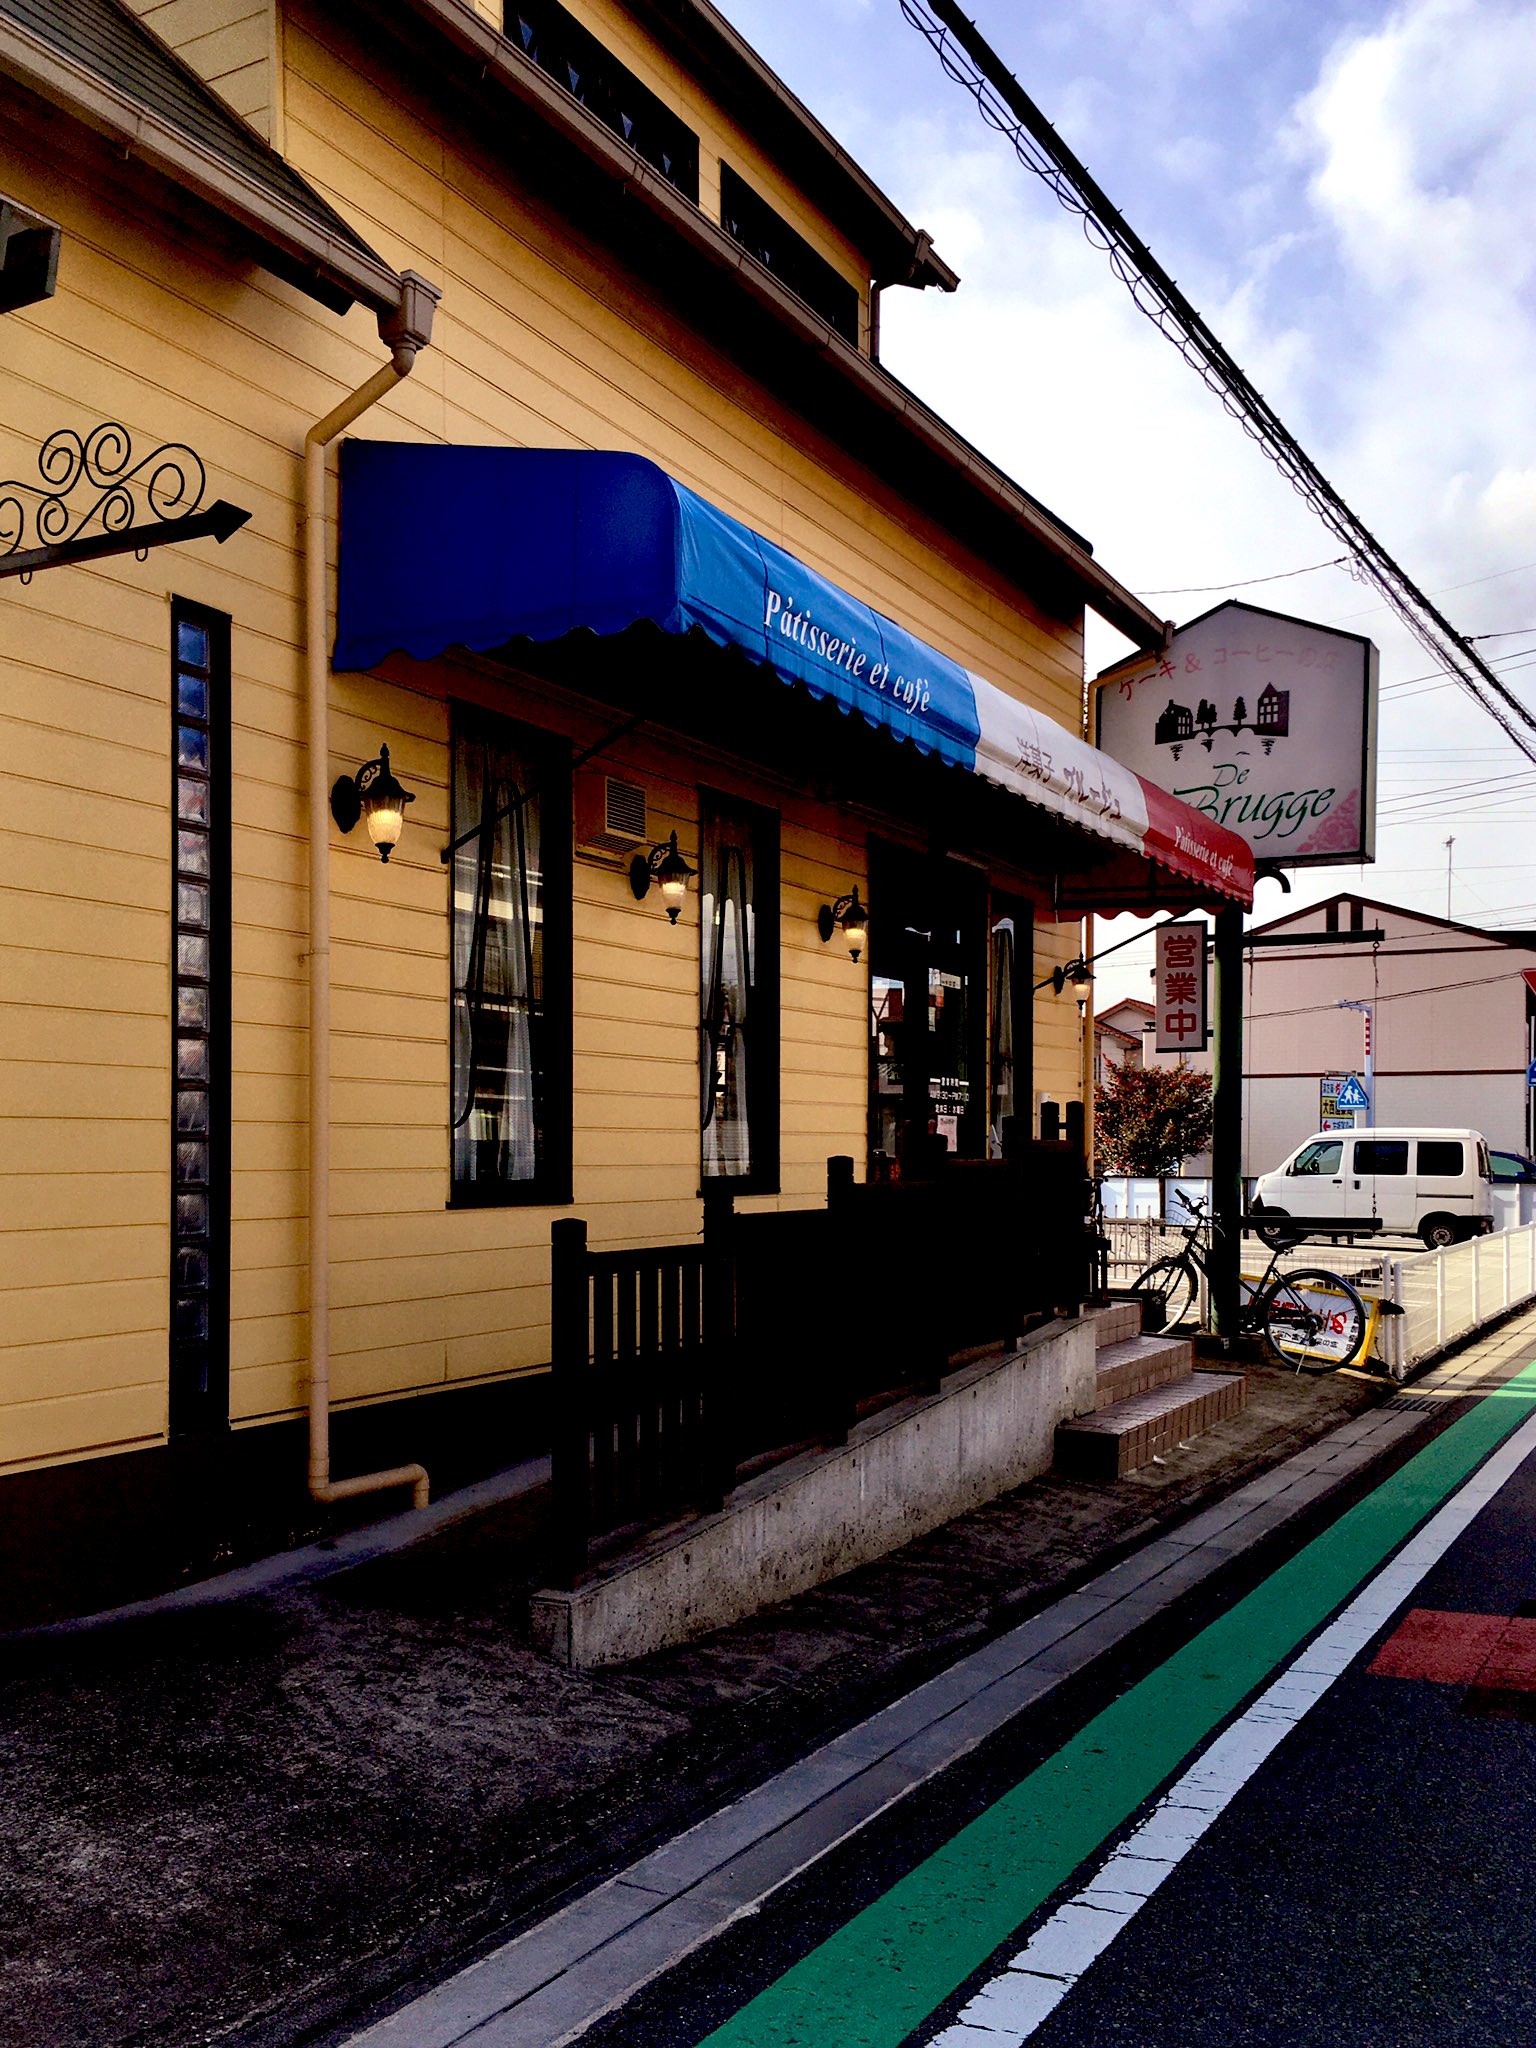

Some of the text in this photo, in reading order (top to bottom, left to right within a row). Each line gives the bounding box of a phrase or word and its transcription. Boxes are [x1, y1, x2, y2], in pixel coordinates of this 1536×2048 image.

[869, 662, 890, 689] et
[1119, 659, 1177, 701] ケーキ
[1184, 653, 1203, 674] &
[1015, 736, 1055, 783] 洋菓子
[1212, 763, 1251, 788] De
[1173, 785, 1336, 840] Brugge
[1164, 934, 1198, 1042] 営業中
